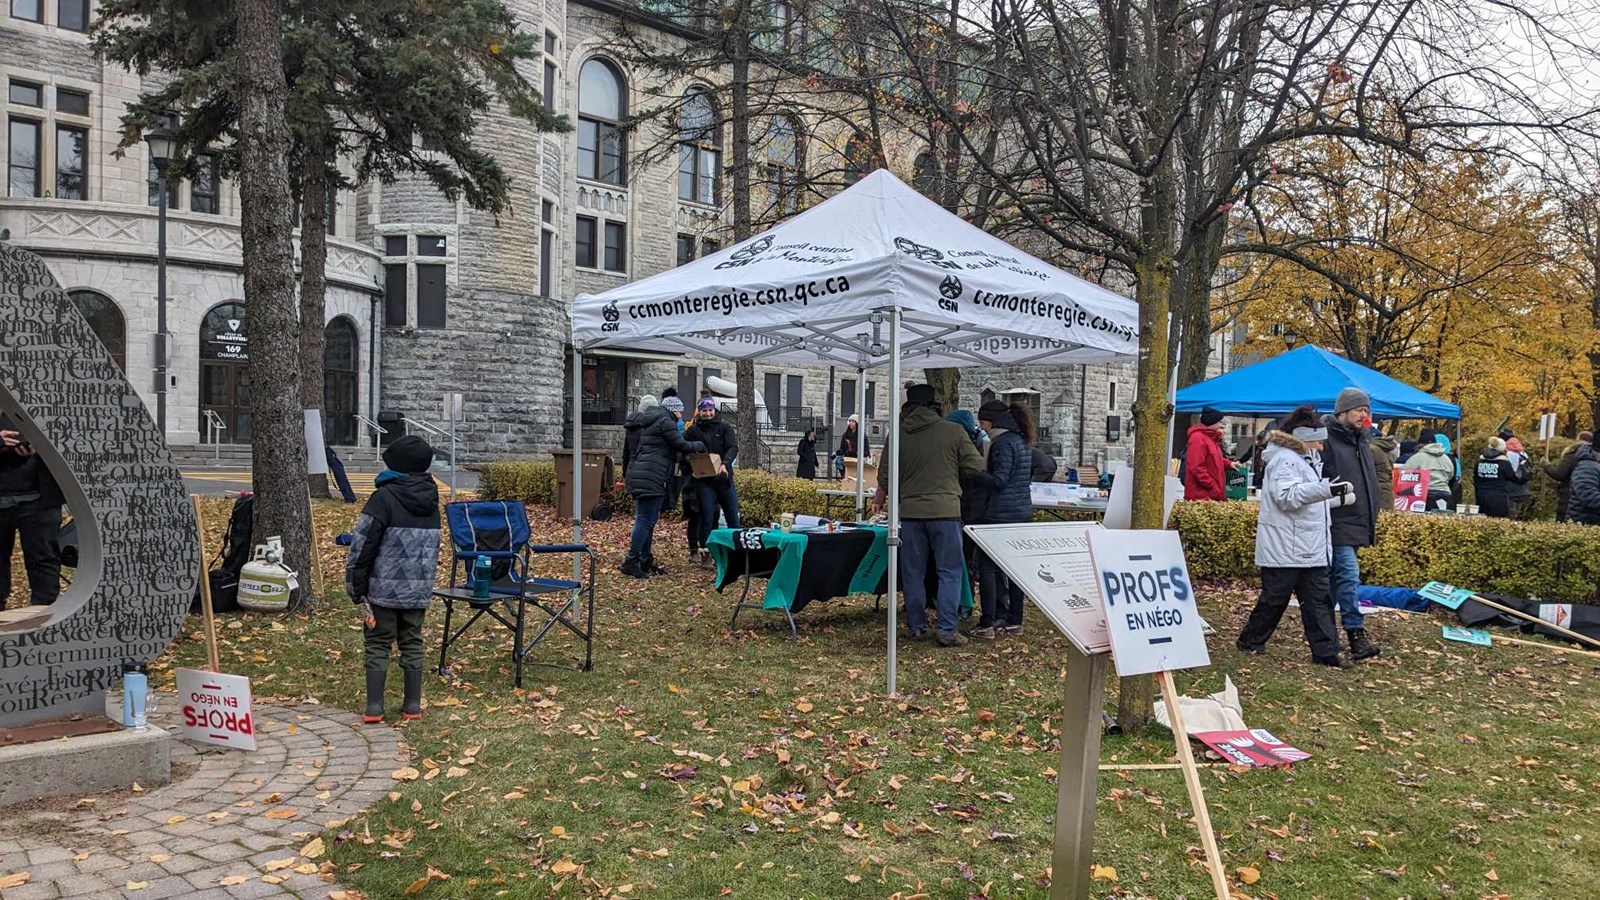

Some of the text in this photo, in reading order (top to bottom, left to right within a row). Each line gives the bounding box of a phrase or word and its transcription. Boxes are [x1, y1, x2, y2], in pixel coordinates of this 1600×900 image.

[926, 260, 964, 271] SN
[628, 274, 851, 319] ccmonteregie.csn.qc.ca
[938, 298, 958, 314] CSN
[600, 321, 621, 332] CSN
[1478, 462, 1499, 474] NOUS
[1006, 538, 1055, 551] VASQUE
[1052, 536, 1077, 548] DES
[1103, 566, 1188, 607] PROFS
[1125, 605, 1183, 631] EN NÉGO
[1, 640, 167, 669] Détermination
[191, 692, 238, 708] EN NÉGO
[183, 705, 252, 735] PROFS
